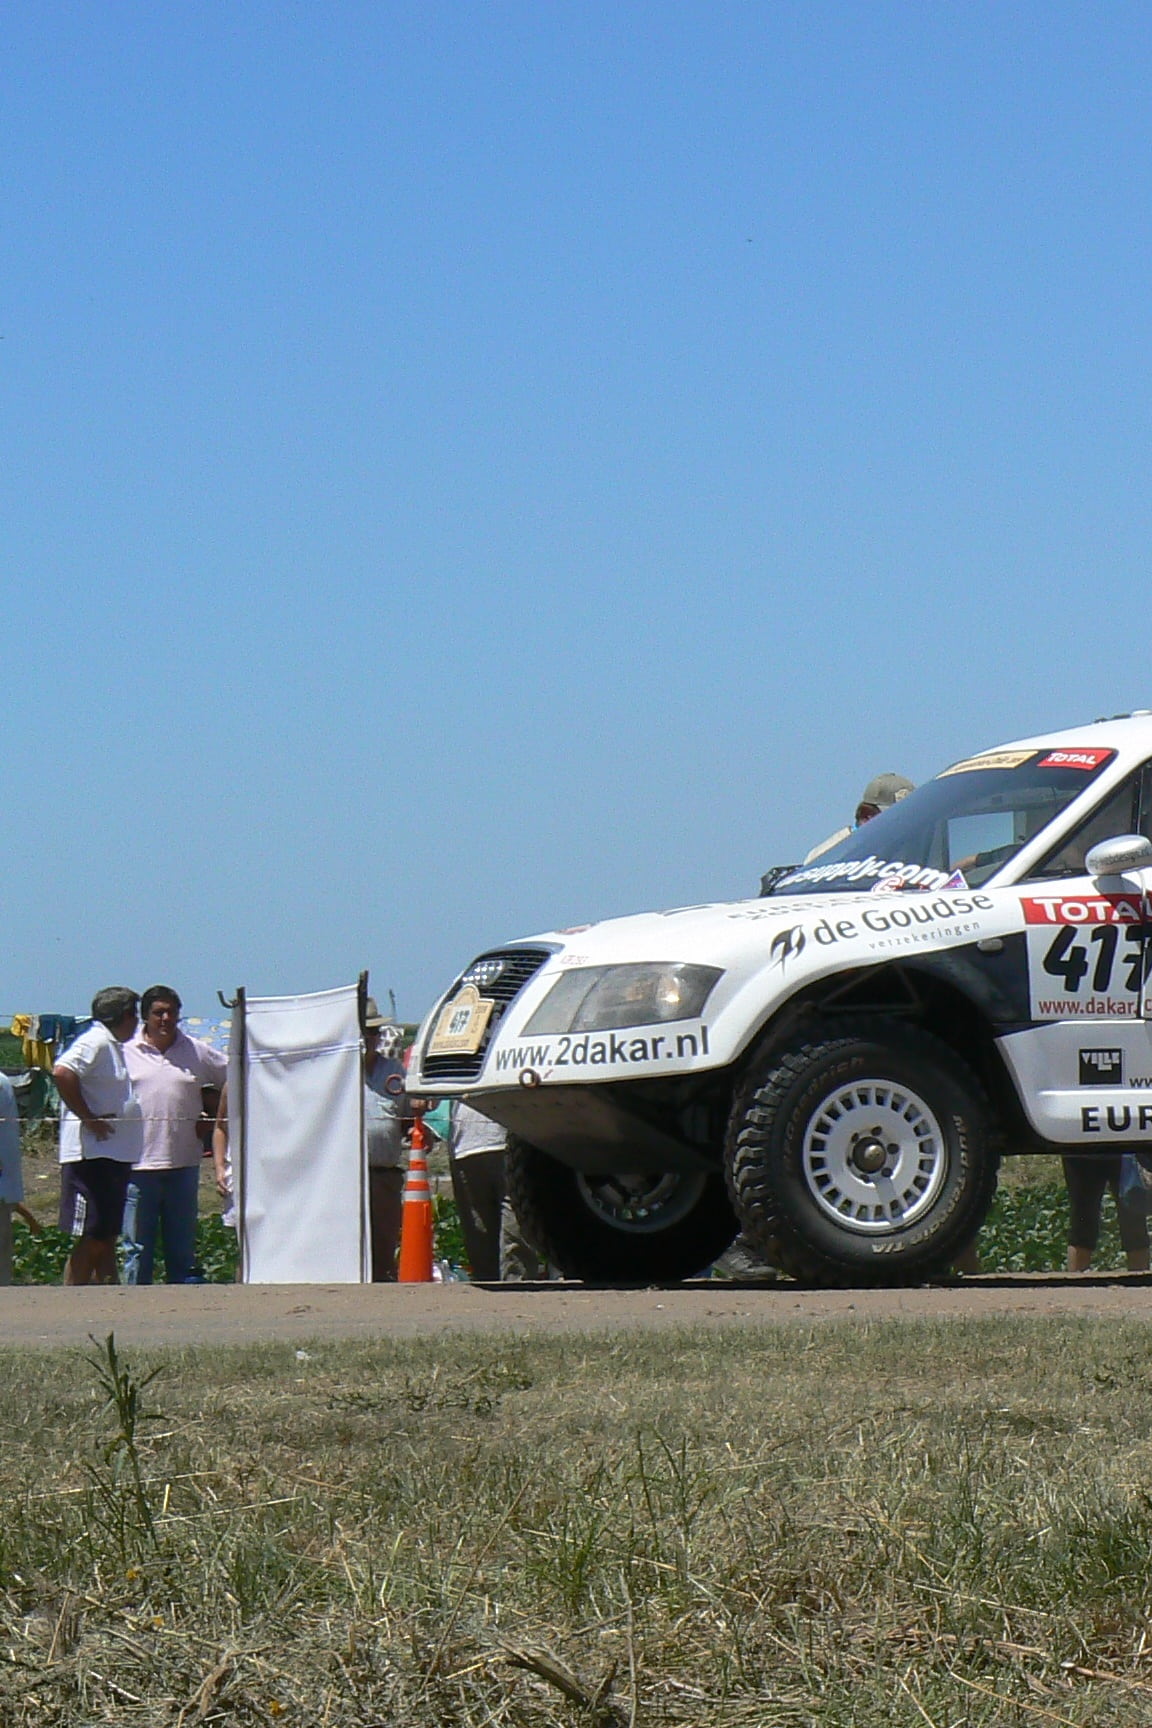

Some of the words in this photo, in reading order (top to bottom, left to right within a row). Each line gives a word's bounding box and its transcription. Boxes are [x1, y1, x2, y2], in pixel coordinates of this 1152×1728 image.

[1048, 752, 1097, 765] TOTAL
[813, 918, 859, 946] de
[861, 893, 995, 932] Goudse
[868, 921, 981, 950] verzekeringen
[496, 1025, 710, 1071] www.2dakar.nl
